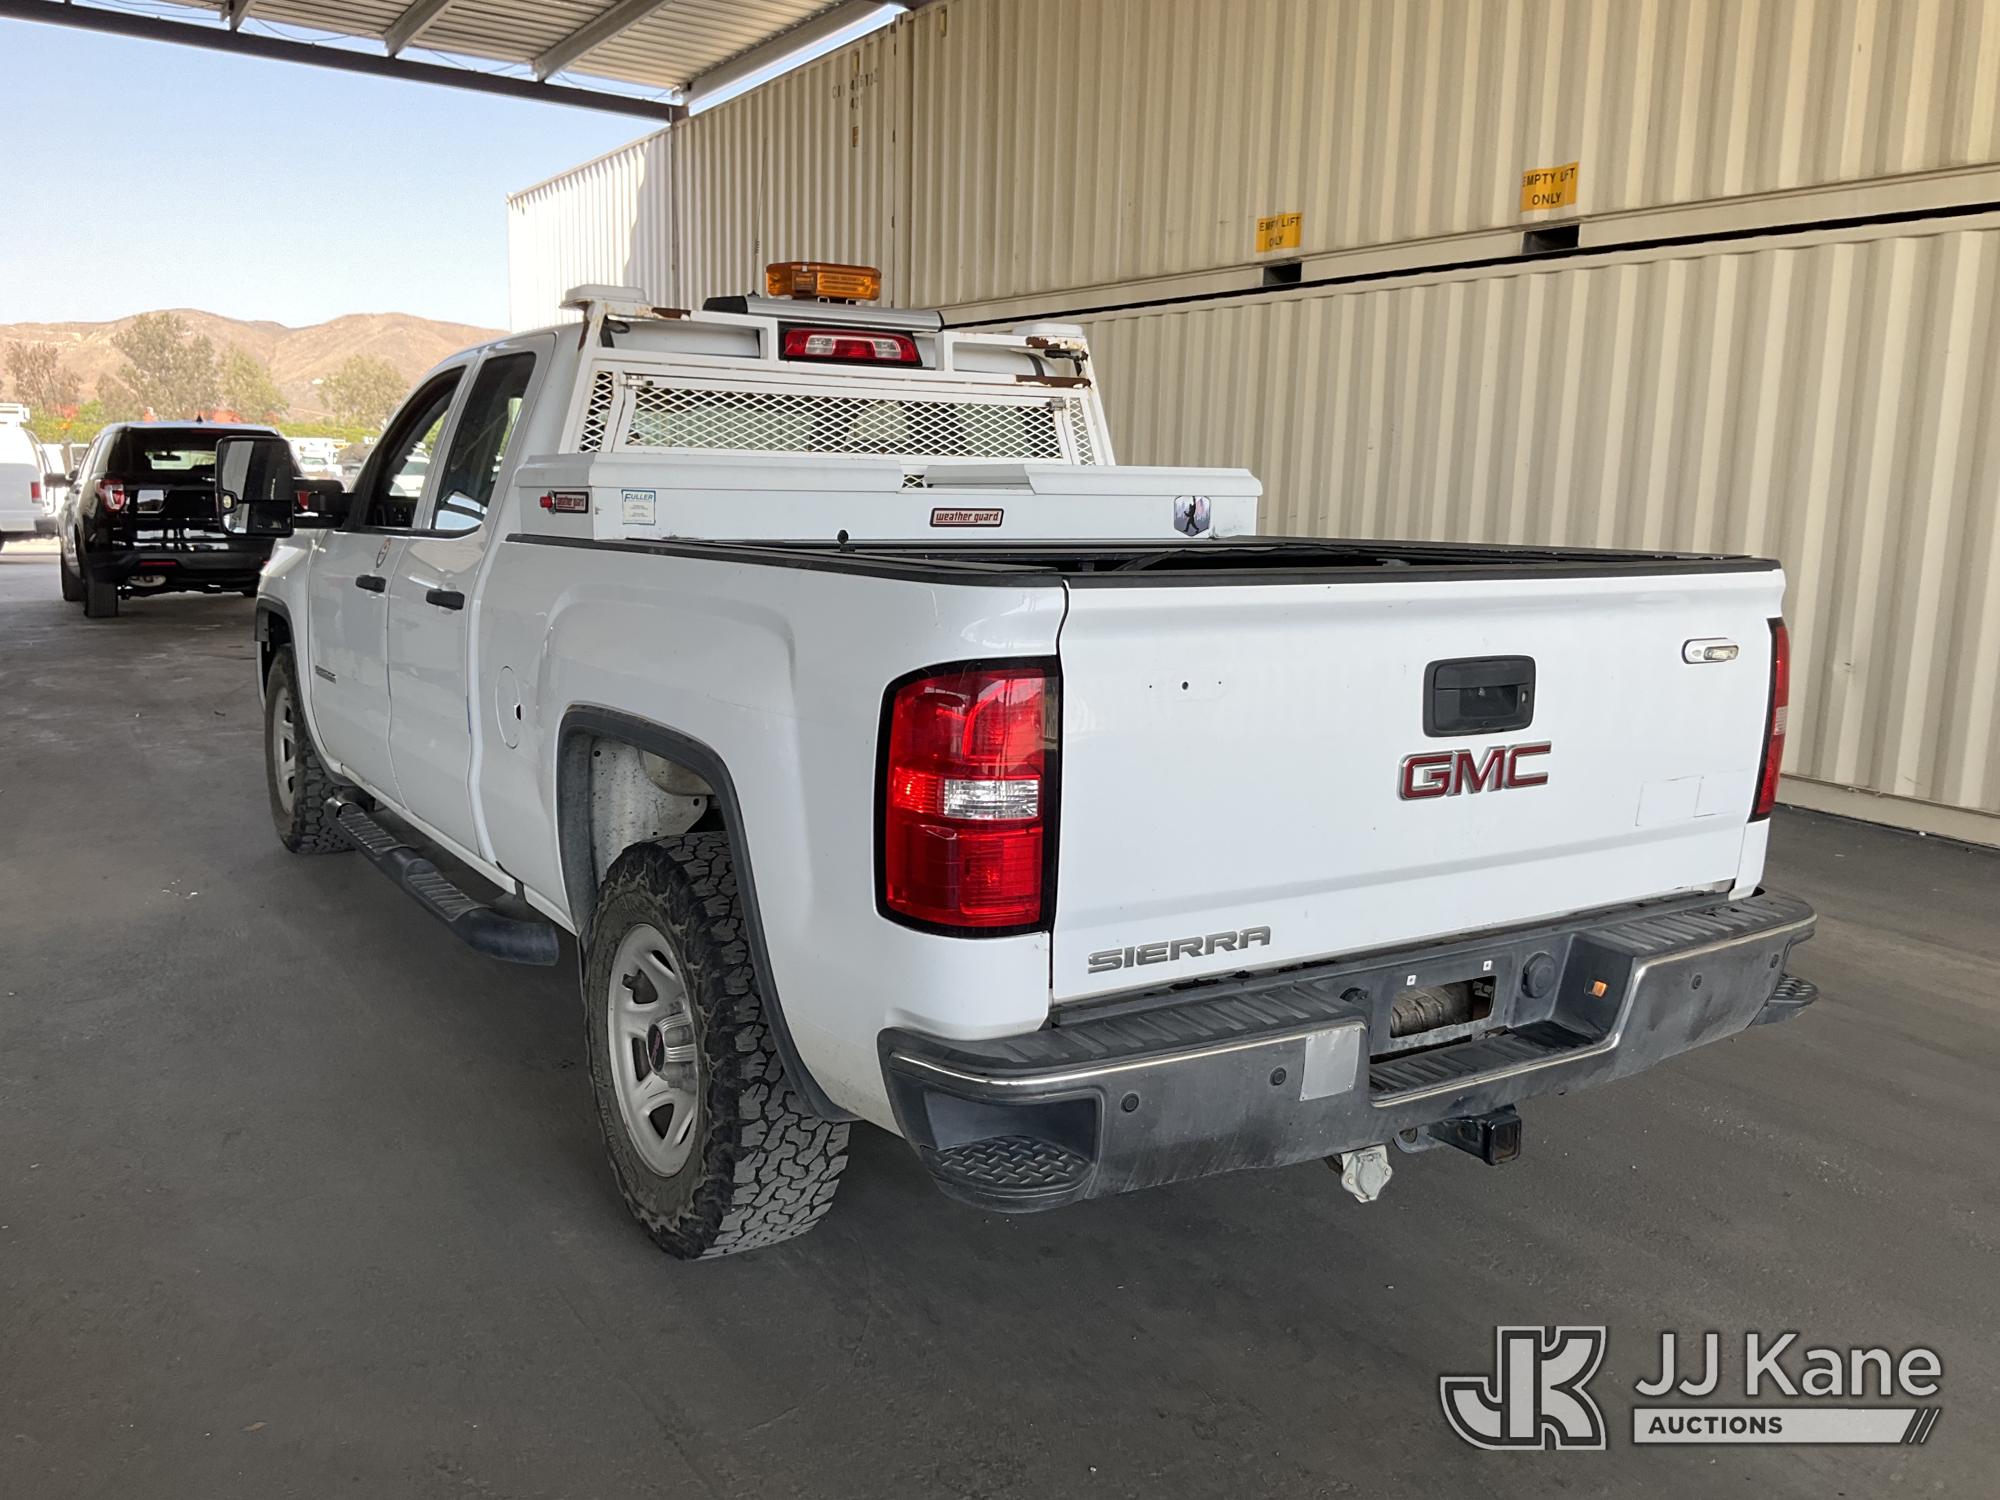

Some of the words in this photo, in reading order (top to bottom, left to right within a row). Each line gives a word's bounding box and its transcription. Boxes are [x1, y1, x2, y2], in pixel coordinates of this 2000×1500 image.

[1522, 172, 1556, 187] EMPTY
[1560, 167, 1575, 182] LFT
[1531, 191, 1561, 205] ONLY
[1269, 235, 1283, 247] OLY
[624, 493, 654, 502] FULLER
[935, 511, 972, 521] weather
[974, 512, 999, 523] guard
[1397, 740, 1552, 800] GMC
[1088, 925, 1271, 974] SIERRA
